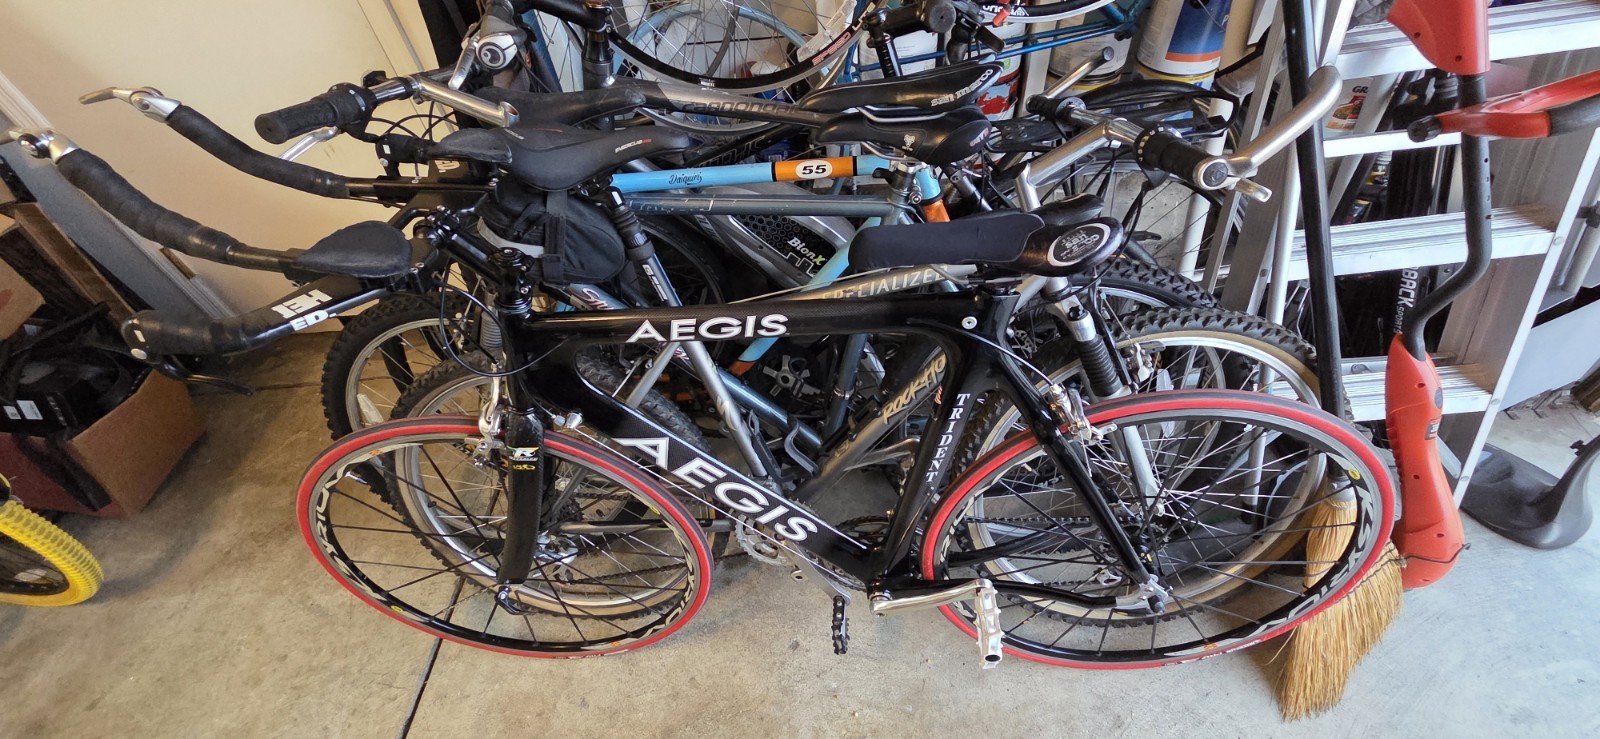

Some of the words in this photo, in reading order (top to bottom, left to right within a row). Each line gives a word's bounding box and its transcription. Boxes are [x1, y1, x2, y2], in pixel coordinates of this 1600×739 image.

[801, 164, 828, 175] 55
[787, 237, 826, 266] BionX
[1397, 267, 1418, 308] BACK
[625, 313, 790, 343] AEGIS
[926, 393, 971, 482] TRIDENT
[611, 436, 818, 542] AEGIS
